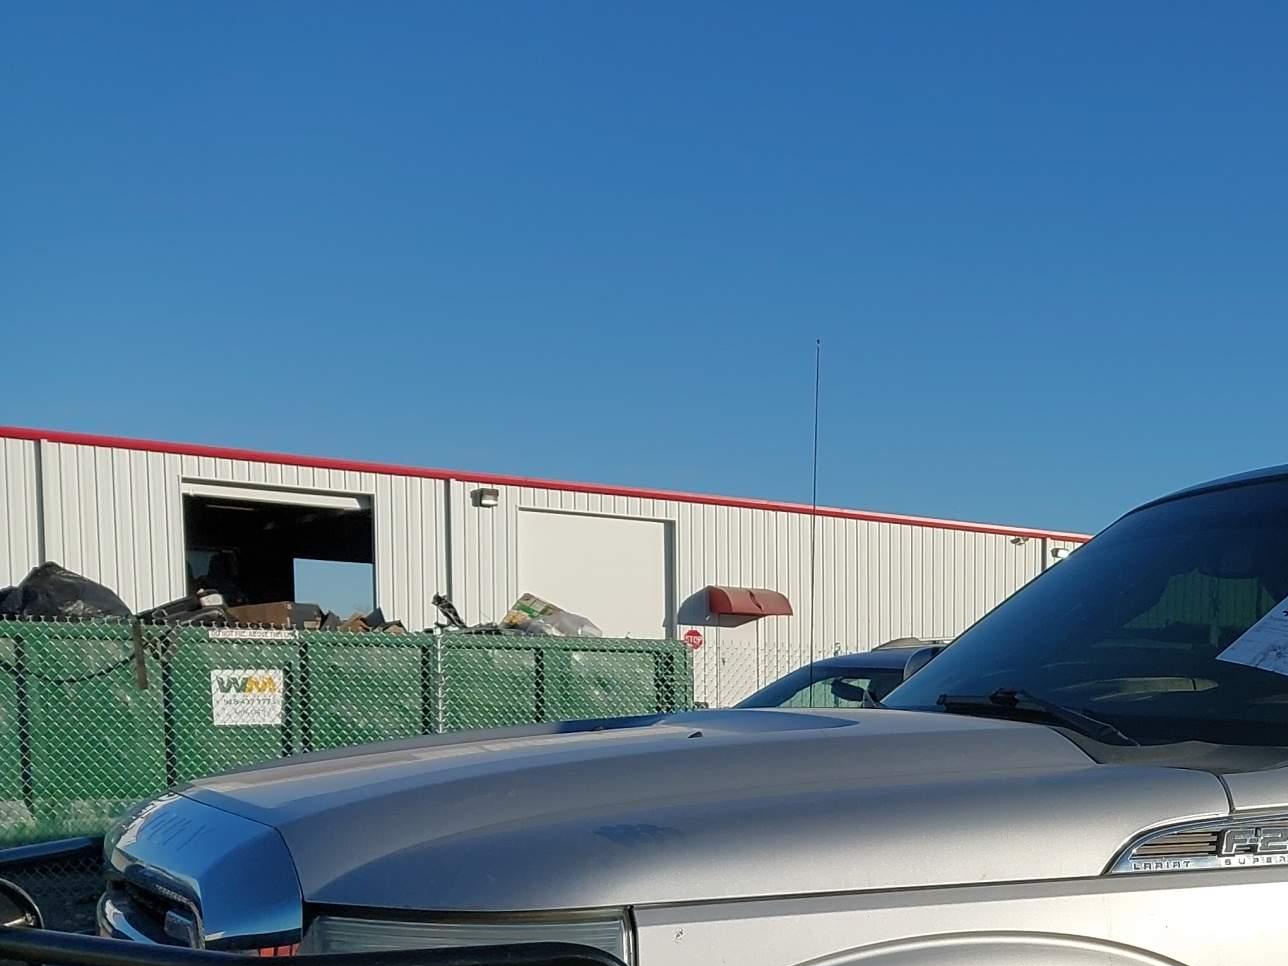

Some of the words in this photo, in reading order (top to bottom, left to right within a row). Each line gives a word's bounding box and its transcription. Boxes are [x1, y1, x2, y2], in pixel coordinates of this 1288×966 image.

[685, 635, 703, 645] STOP
[216, 676, 276, 693] WM
[1132, 860, 1191, 871] LARIAT
[1224, 855, 1287, 867] SUPER
